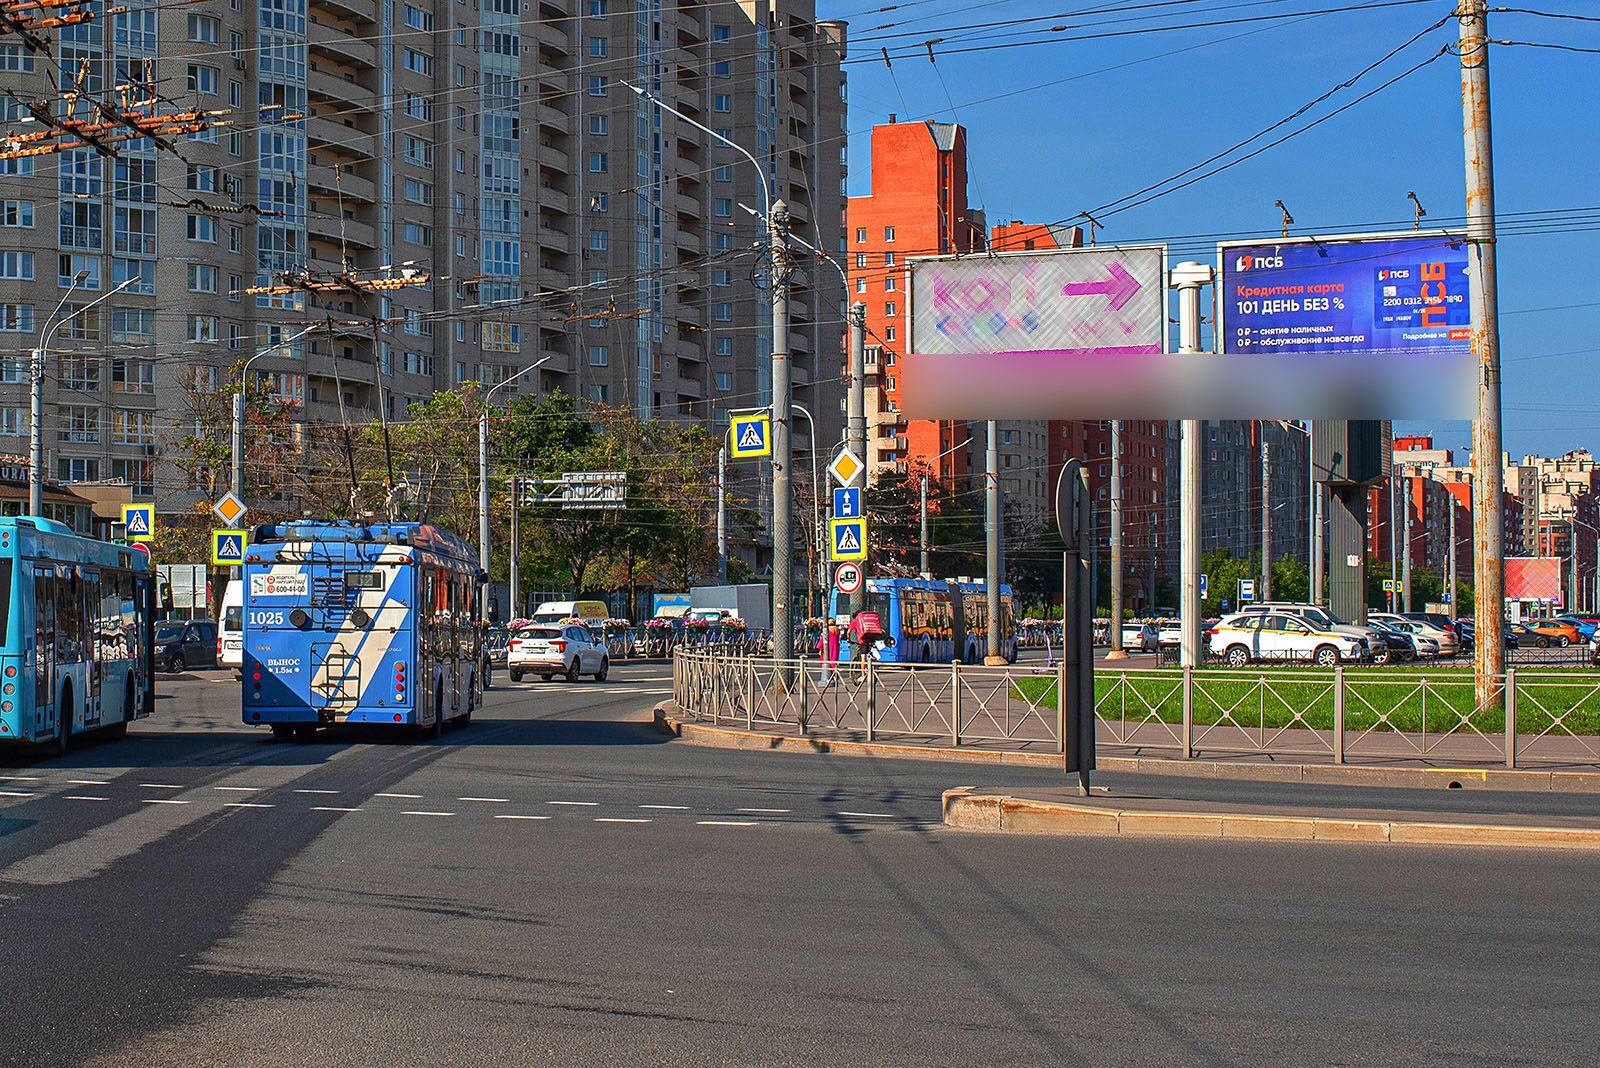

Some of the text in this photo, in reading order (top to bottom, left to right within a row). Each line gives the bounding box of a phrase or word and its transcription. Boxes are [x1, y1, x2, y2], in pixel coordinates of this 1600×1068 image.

[1254, 256, 1284, 269] ПСБ
[1390, 270, 1410, 279] ПСБ
[1236, 283, 1345, 298] Кредитная карта
[1420, 262, 1447, 328] ПСБ
[1236, 297, 1345, 315] 101 ДЕНЬ БЕЗ %
[1260, 327, 1289, 336] снятие
[1291, 325, 1334, 334] наличных
[1260, 337, 1322, 347] обслуживание
[1323, 335, 1365, 344] навсегда
[275, 585, 306, 593] 600-44-00
[249, 611, 284, 625] 1025
[267, 658, 301, 666] ВЫНОС
